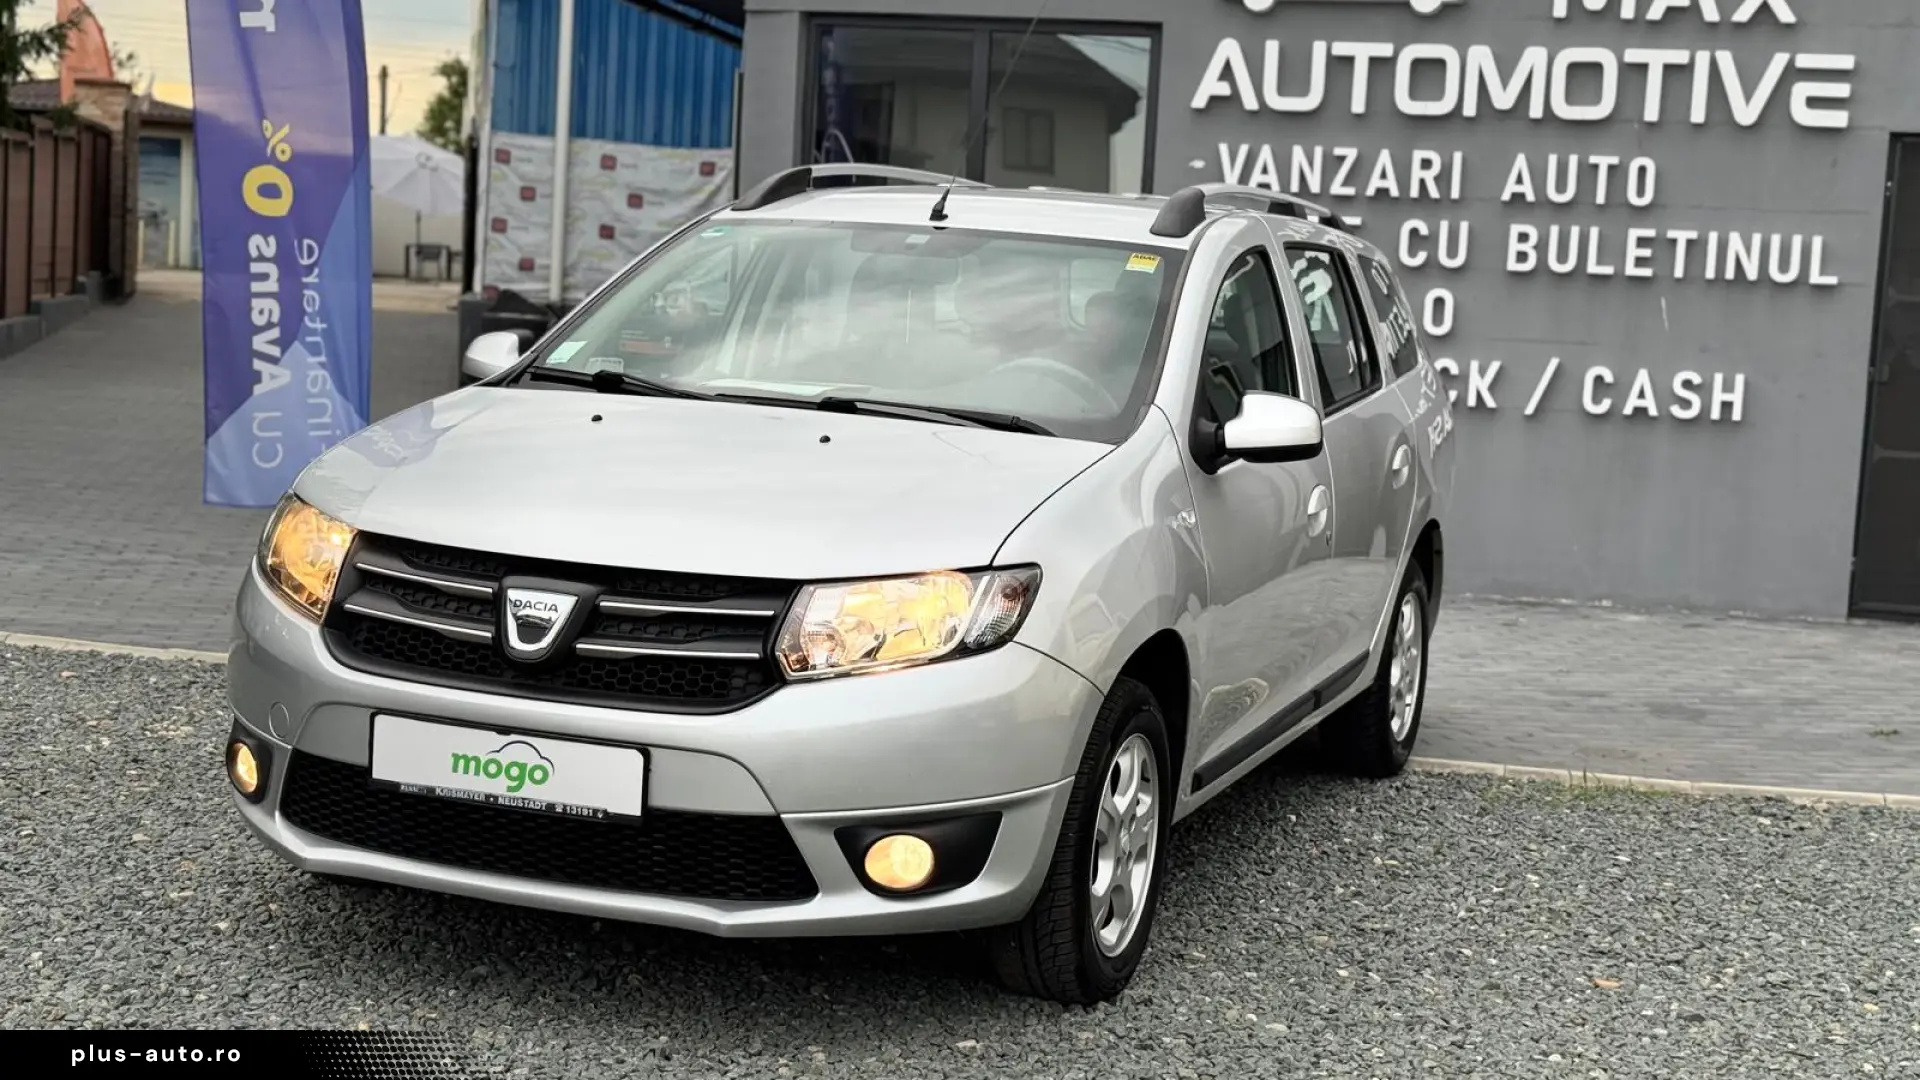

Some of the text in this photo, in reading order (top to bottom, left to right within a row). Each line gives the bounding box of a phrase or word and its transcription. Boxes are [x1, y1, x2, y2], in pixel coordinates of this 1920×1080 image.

[1190, 37, 1856, 128] AUTOMOTIVE
[1500, 153, 1656, 207] AUTO
[1398, 218, 1839, 285] CU BULETINUL
[1582, 365, 1745, 421] CASH
[512, 599, 559, 613] DACIA
[451, 752, 550, 793] mogo
[497, 796, 548, 811] NEUSTADT
